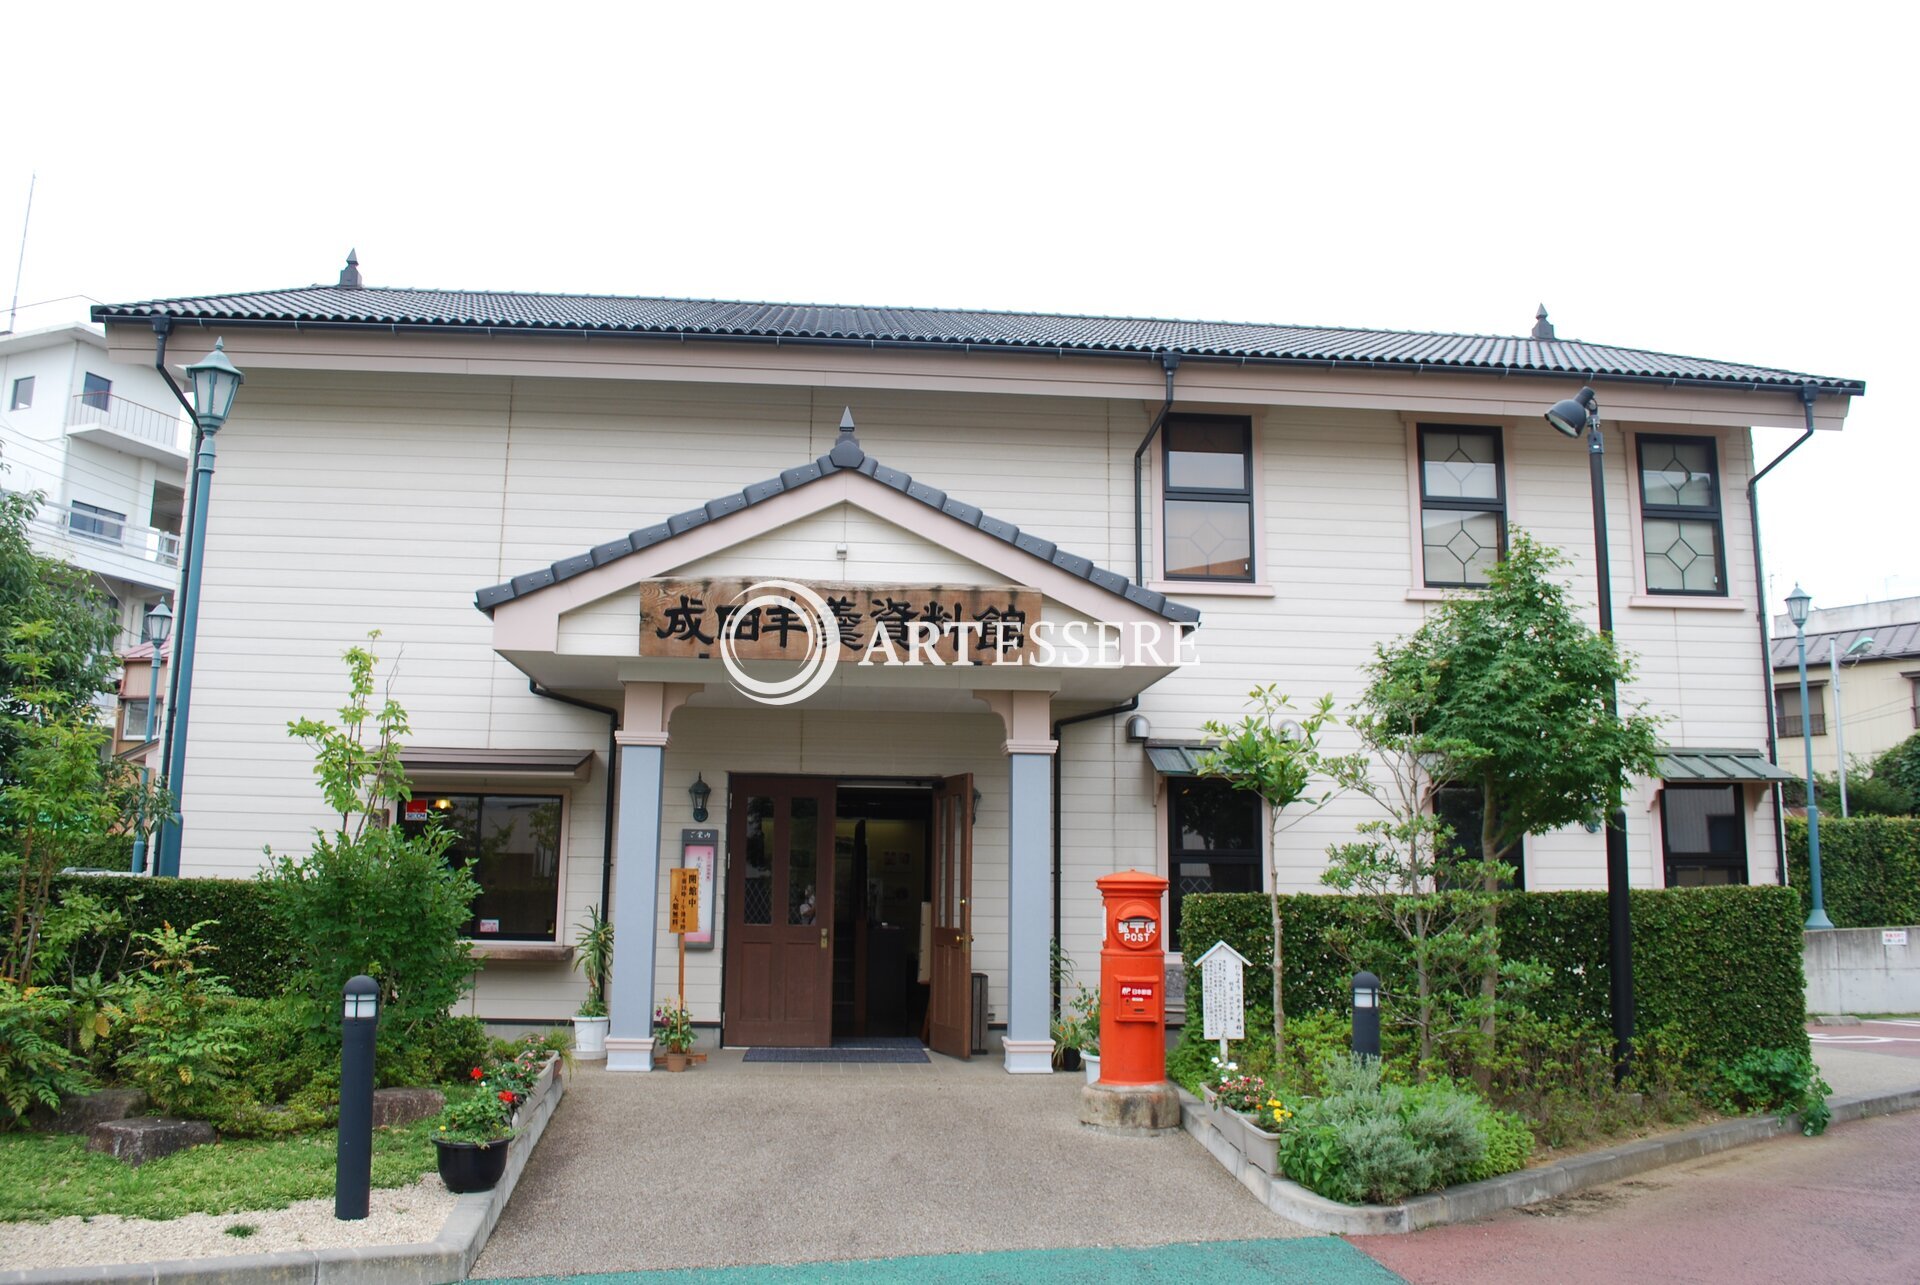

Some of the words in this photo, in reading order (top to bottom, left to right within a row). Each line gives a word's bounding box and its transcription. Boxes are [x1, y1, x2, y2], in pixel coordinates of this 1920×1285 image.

[688, 874, 697, 908] 開館中
[1124, 933, 1150, 942] POST
